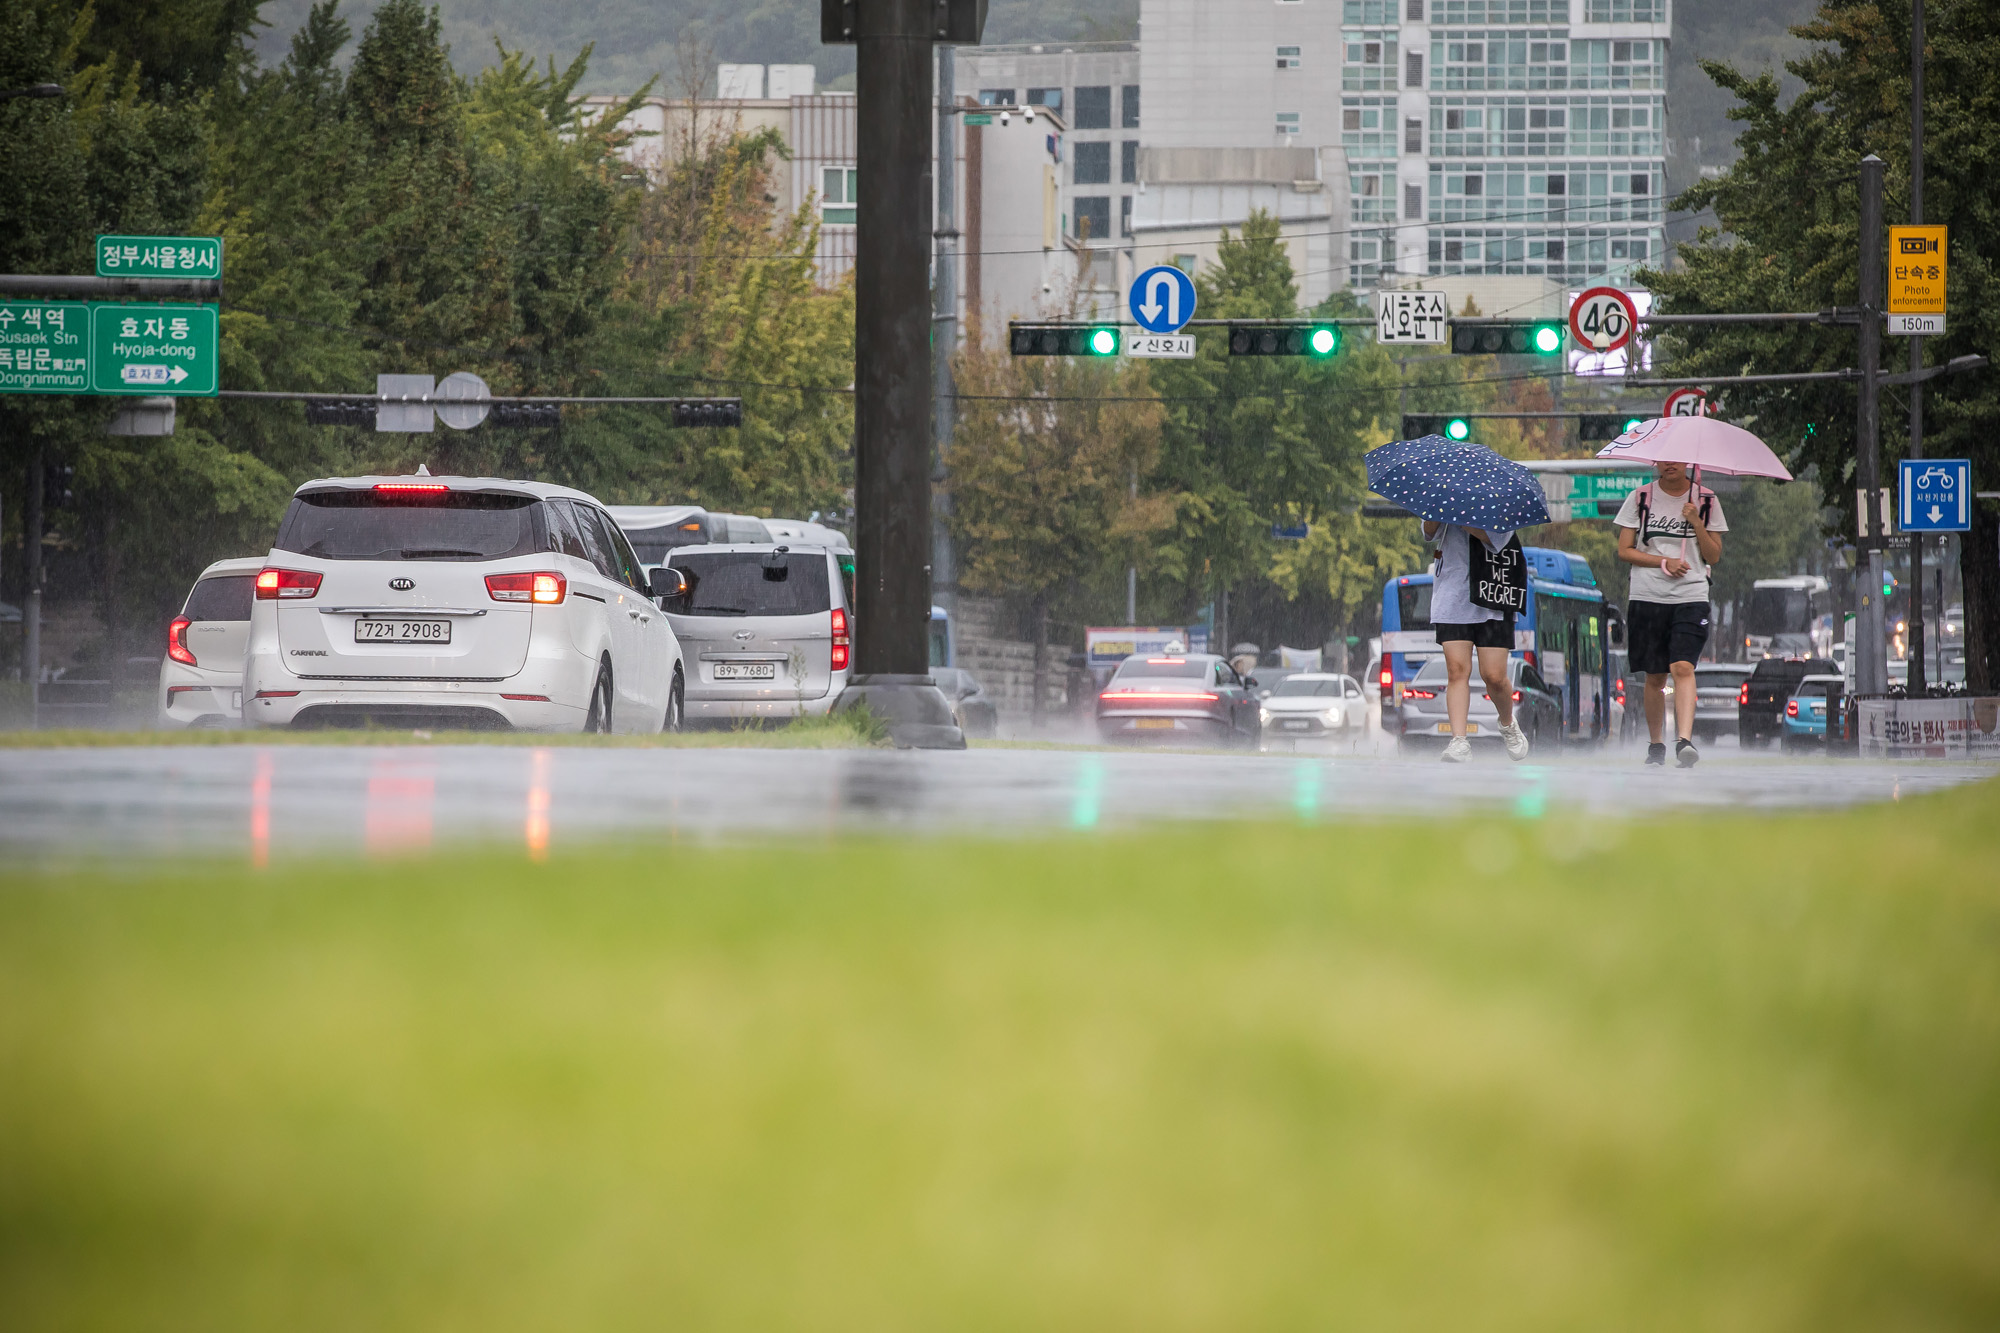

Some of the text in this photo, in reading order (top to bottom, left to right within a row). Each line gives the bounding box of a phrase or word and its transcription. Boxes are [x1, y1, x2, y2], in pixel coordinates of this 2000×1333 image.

[103, 245, 216, 270] 정부서울청사
[1895, 265, 1940, 280] 단속중
[1904, 285, 1930, 295] Photo
[1892, 297, 1942, 305] enforcement
[0, 308, 64, 330] 수색역
[1381, 294, 1443, 340] 신호준수
[1583, 302, 1623, 337] 40
[1901, 317, 1934, 331] 150m
[119, 317, 190, 340] 효자동
[54, 330, 78, 345] Stn
[112, 342, 196, 360] Hyoja-dong
[1147, 339, 1189, 353] 신호시
[0, 348, 51, 371] 독립문
[128, 368, 165, 379] 효자로
[1485, 549, 1519, 565] LEST
[1492, 565, 1510, 584] WE
[392, 580, 412, 588] KIA
[1479, 580, 1526, 609] REGRET
[365, 623, 441, 638] 72거 2908
[743, 666, 768, 676] 7680
